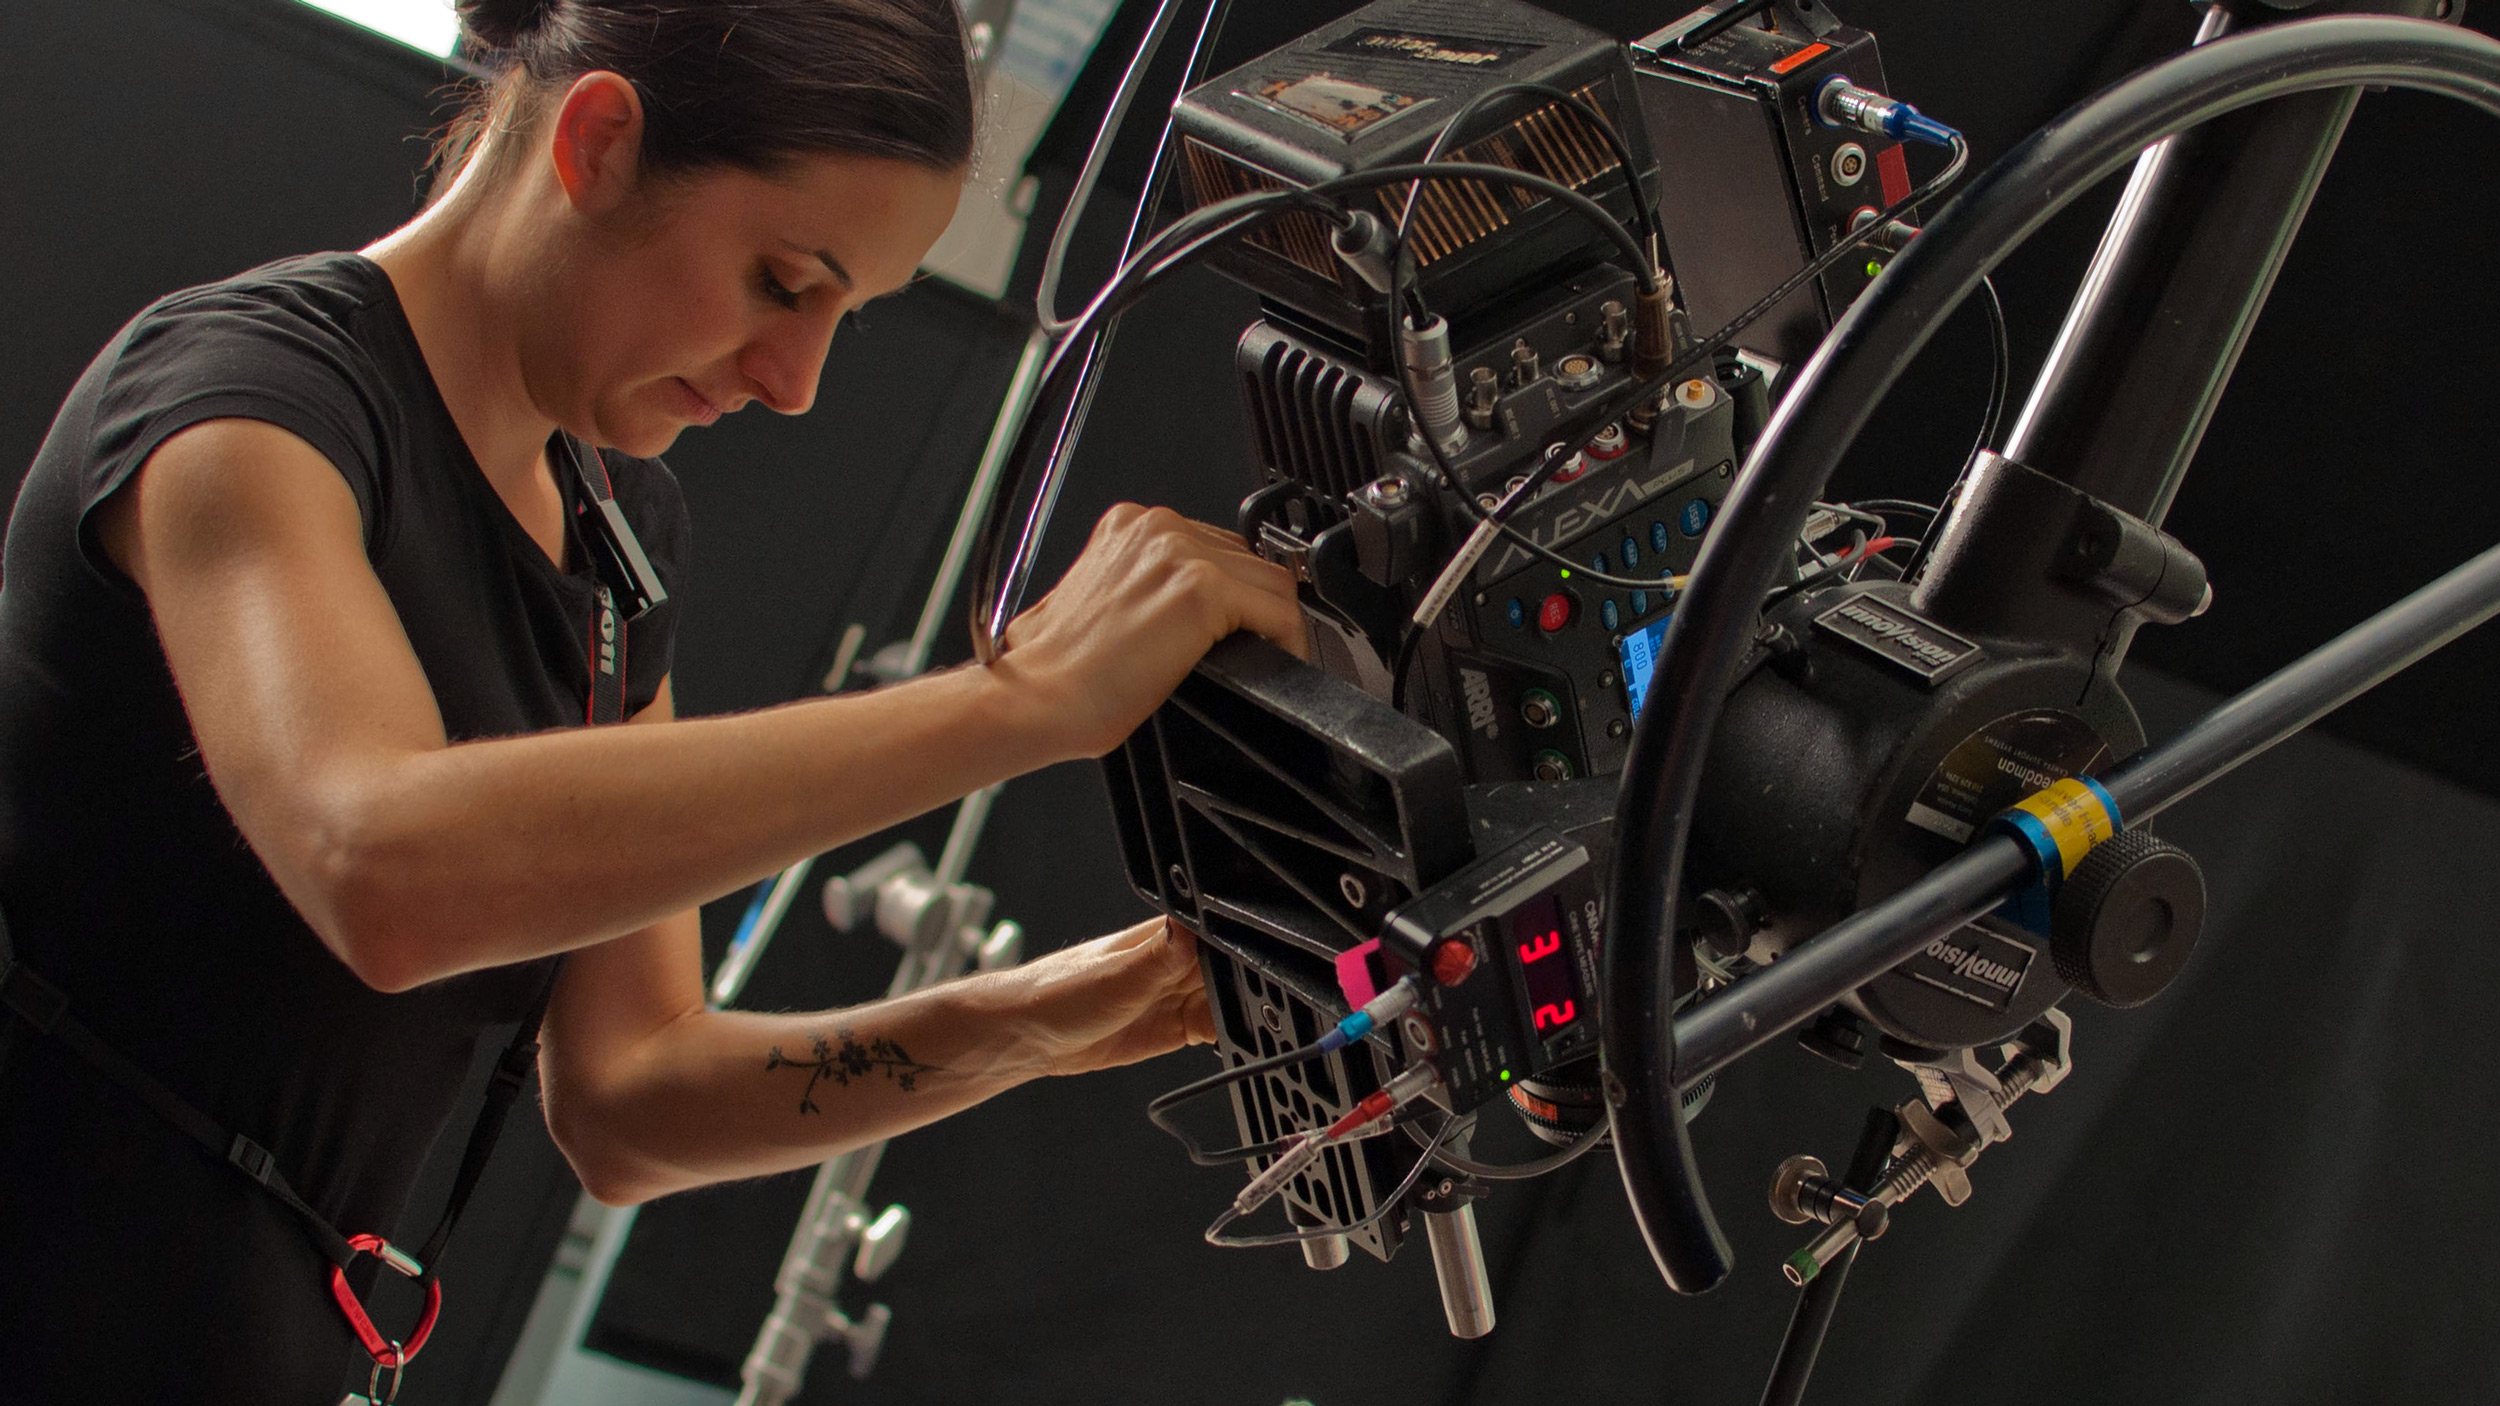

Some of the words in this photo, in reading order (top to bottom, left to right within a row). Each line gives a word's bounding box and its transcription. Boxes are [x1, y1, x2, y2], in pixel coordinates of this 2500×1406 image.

[1812, 153, 1830, 202] Command
[1688, 504, 1700, 531] USER
[1548, 602, 1561, 621] REC
[1633, 642, 1647, 670] 800
[1460, 669, 1495, 729] ARRI
[1632, 698, 1640, 719] COLO
[1984, 736, 2011, 752] SYSTEMS
[2012, 748, 2040, 764] SUPPORT
[1998, 758, 2055, 789] eadman
[1926, 939, 2020, 988] innoVisio
